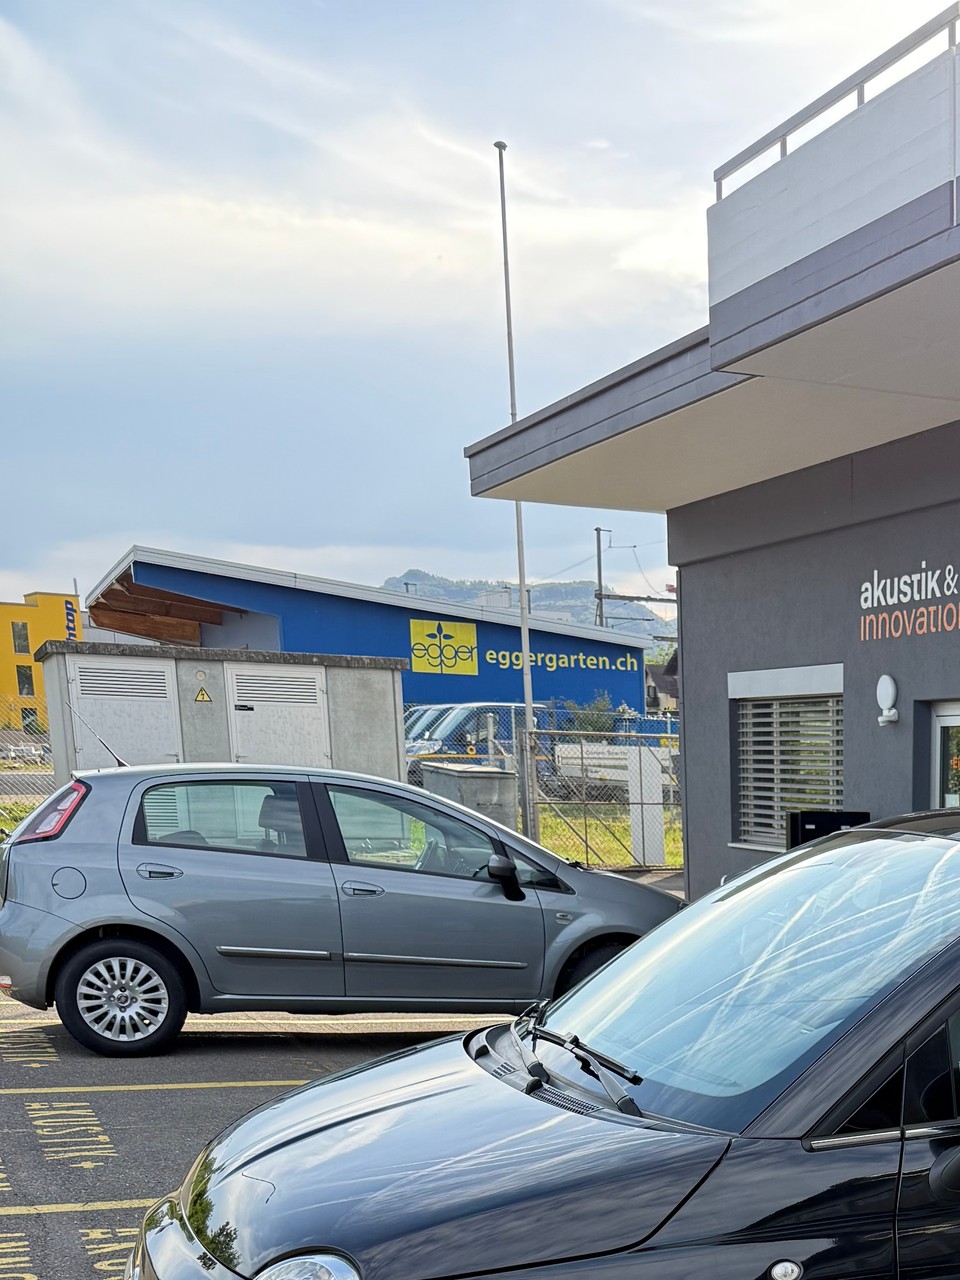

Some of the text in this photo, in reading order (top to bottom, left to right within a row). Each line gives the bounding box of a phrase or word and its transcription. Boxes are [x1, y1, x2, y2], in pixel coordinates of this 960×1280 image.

[860, 560, 959, 610] akustik &
[411, 643, 477, 668] egger
[485, 649, 638, 672] eggergarten.ch
